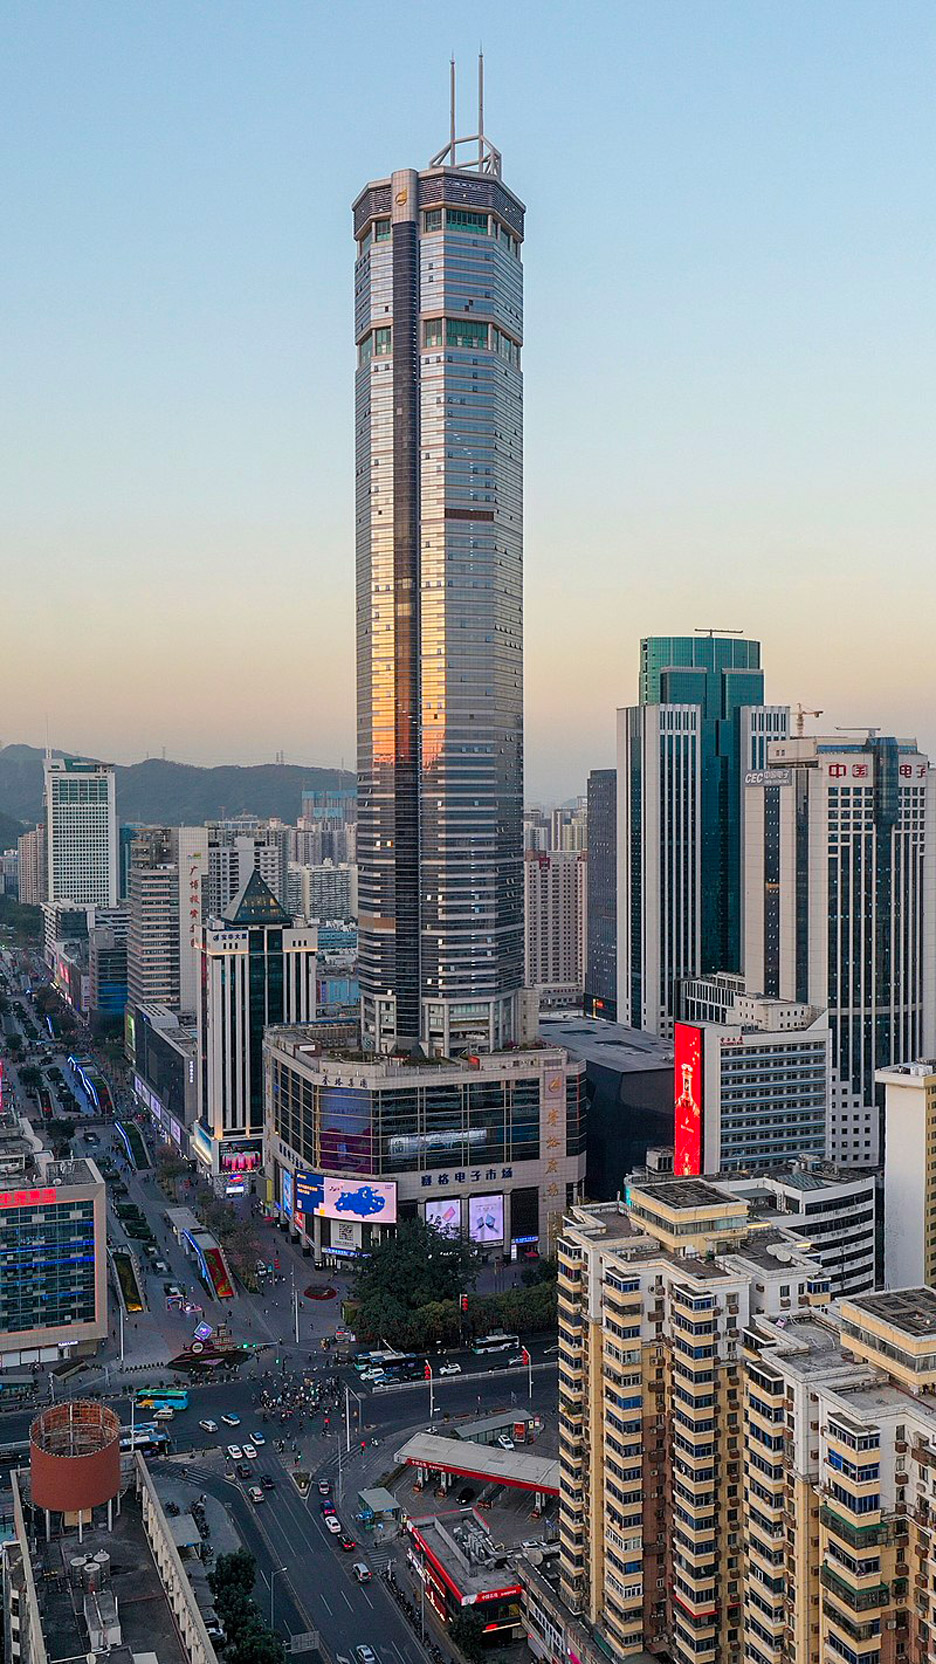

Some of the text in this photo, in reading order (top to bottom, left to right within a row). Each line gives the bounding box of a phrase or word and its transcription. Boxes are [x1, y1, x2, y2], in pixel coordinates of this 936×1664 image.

[745, 773, 763, 784] CEC
[421, 1167, 513, 1187] 赛格电子市场
